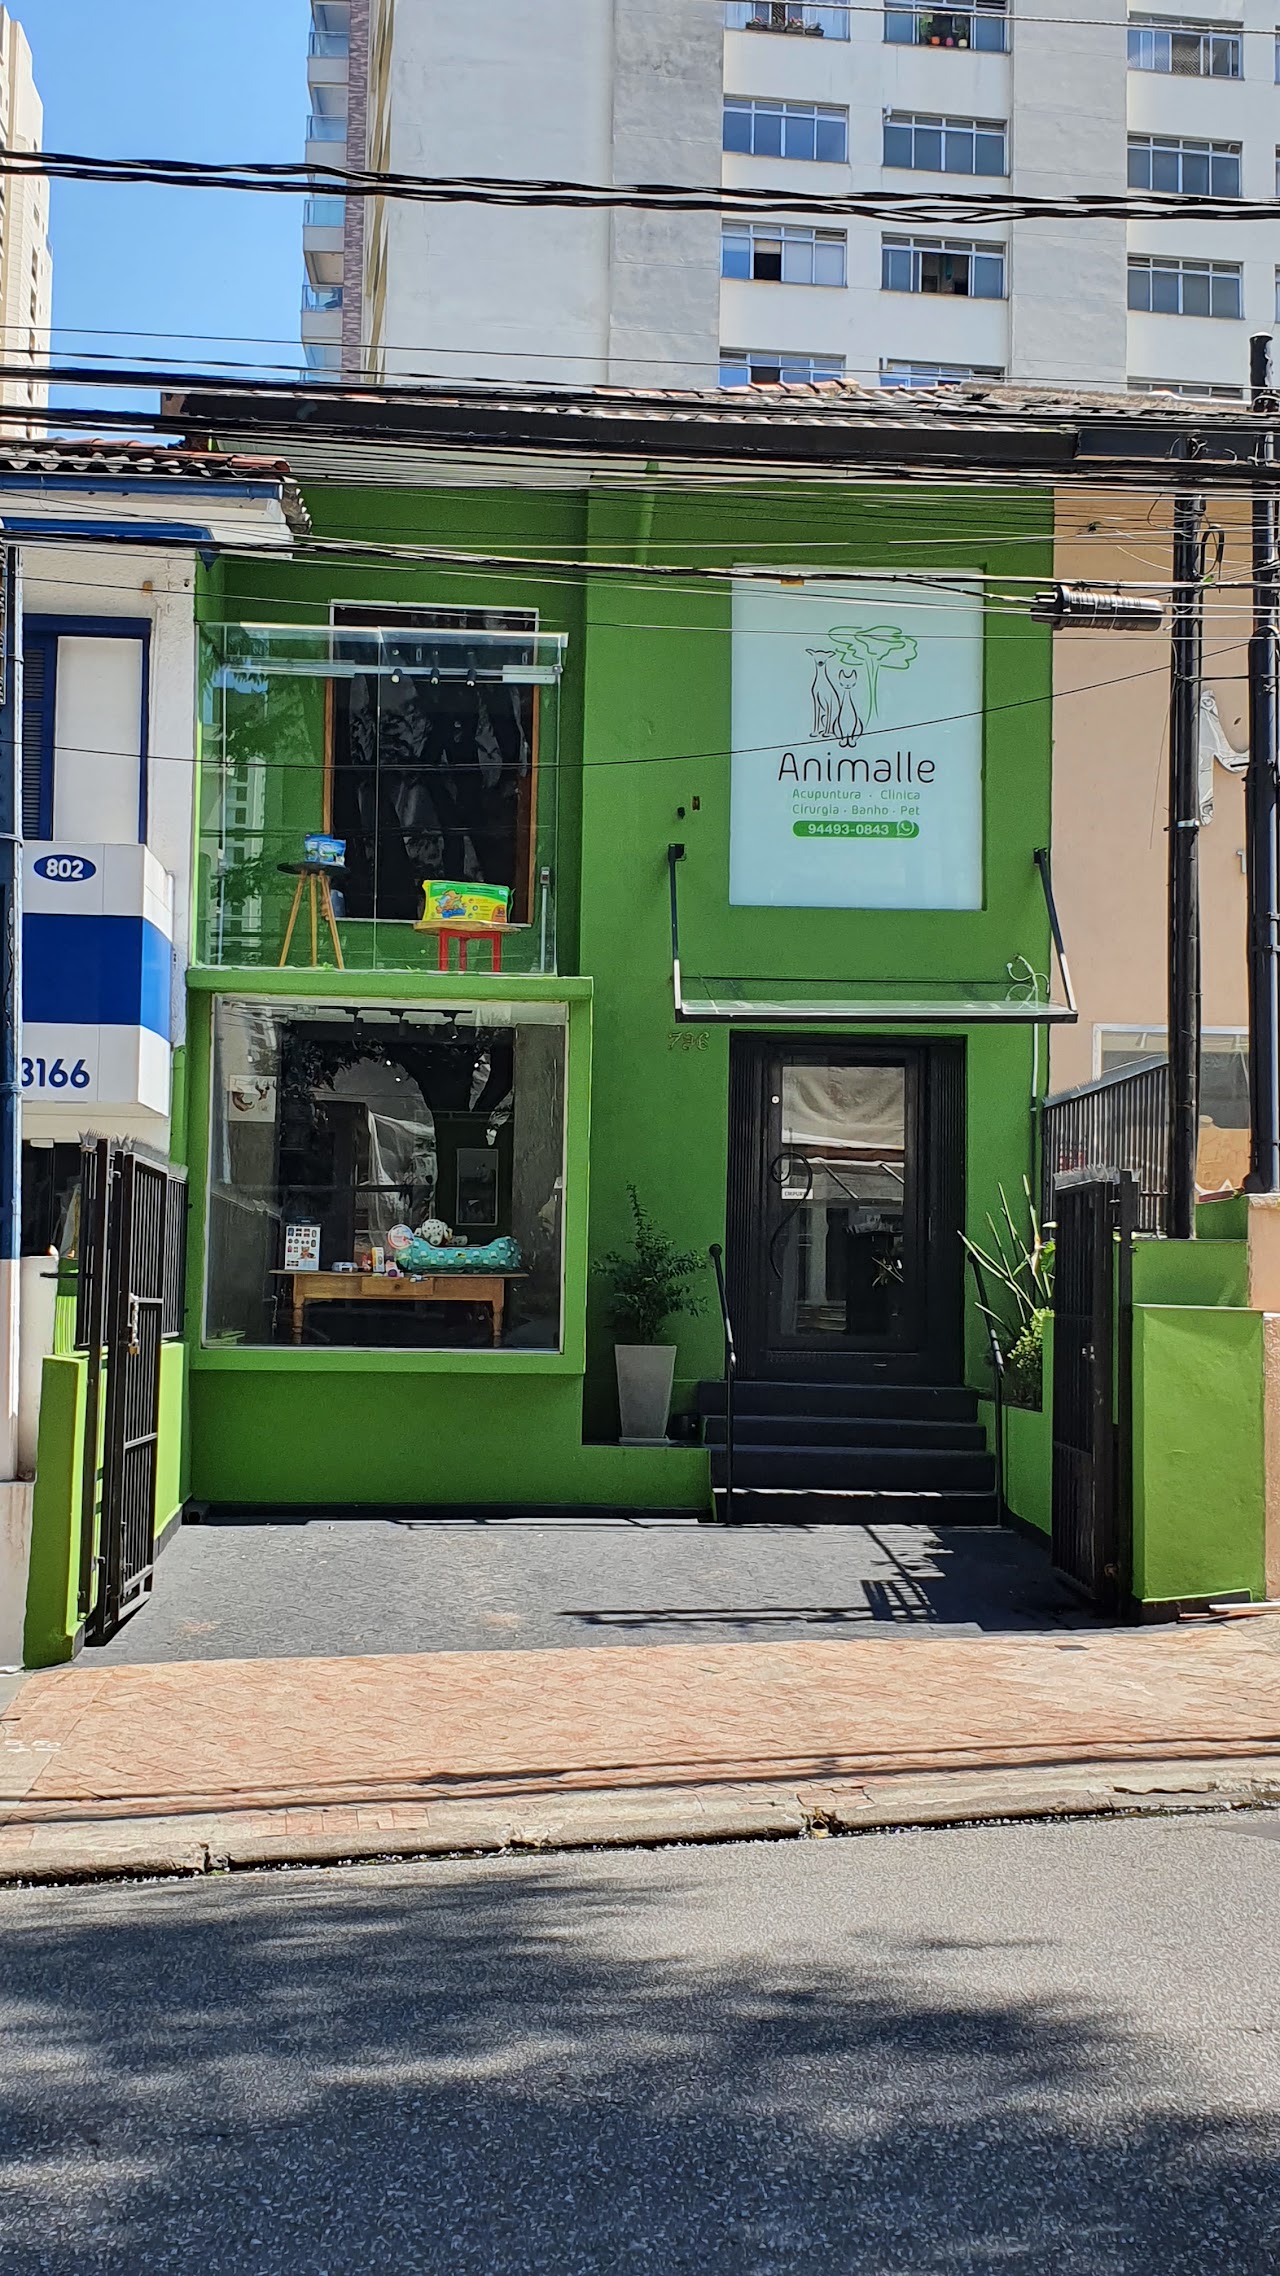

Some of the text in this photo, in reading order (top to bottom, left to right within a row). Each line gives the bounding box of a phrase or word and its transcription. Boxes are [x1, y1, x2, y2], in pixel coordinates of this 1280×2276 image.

[777, 751, 936, 784] Animalle
[792, 788, 861, 801] Acupuntura
[792, 803, 920, 817] Cirurgia Banho Pet
[807, 823, 889, 835] 94493-0843
[46, 857, 84, 879] 802
